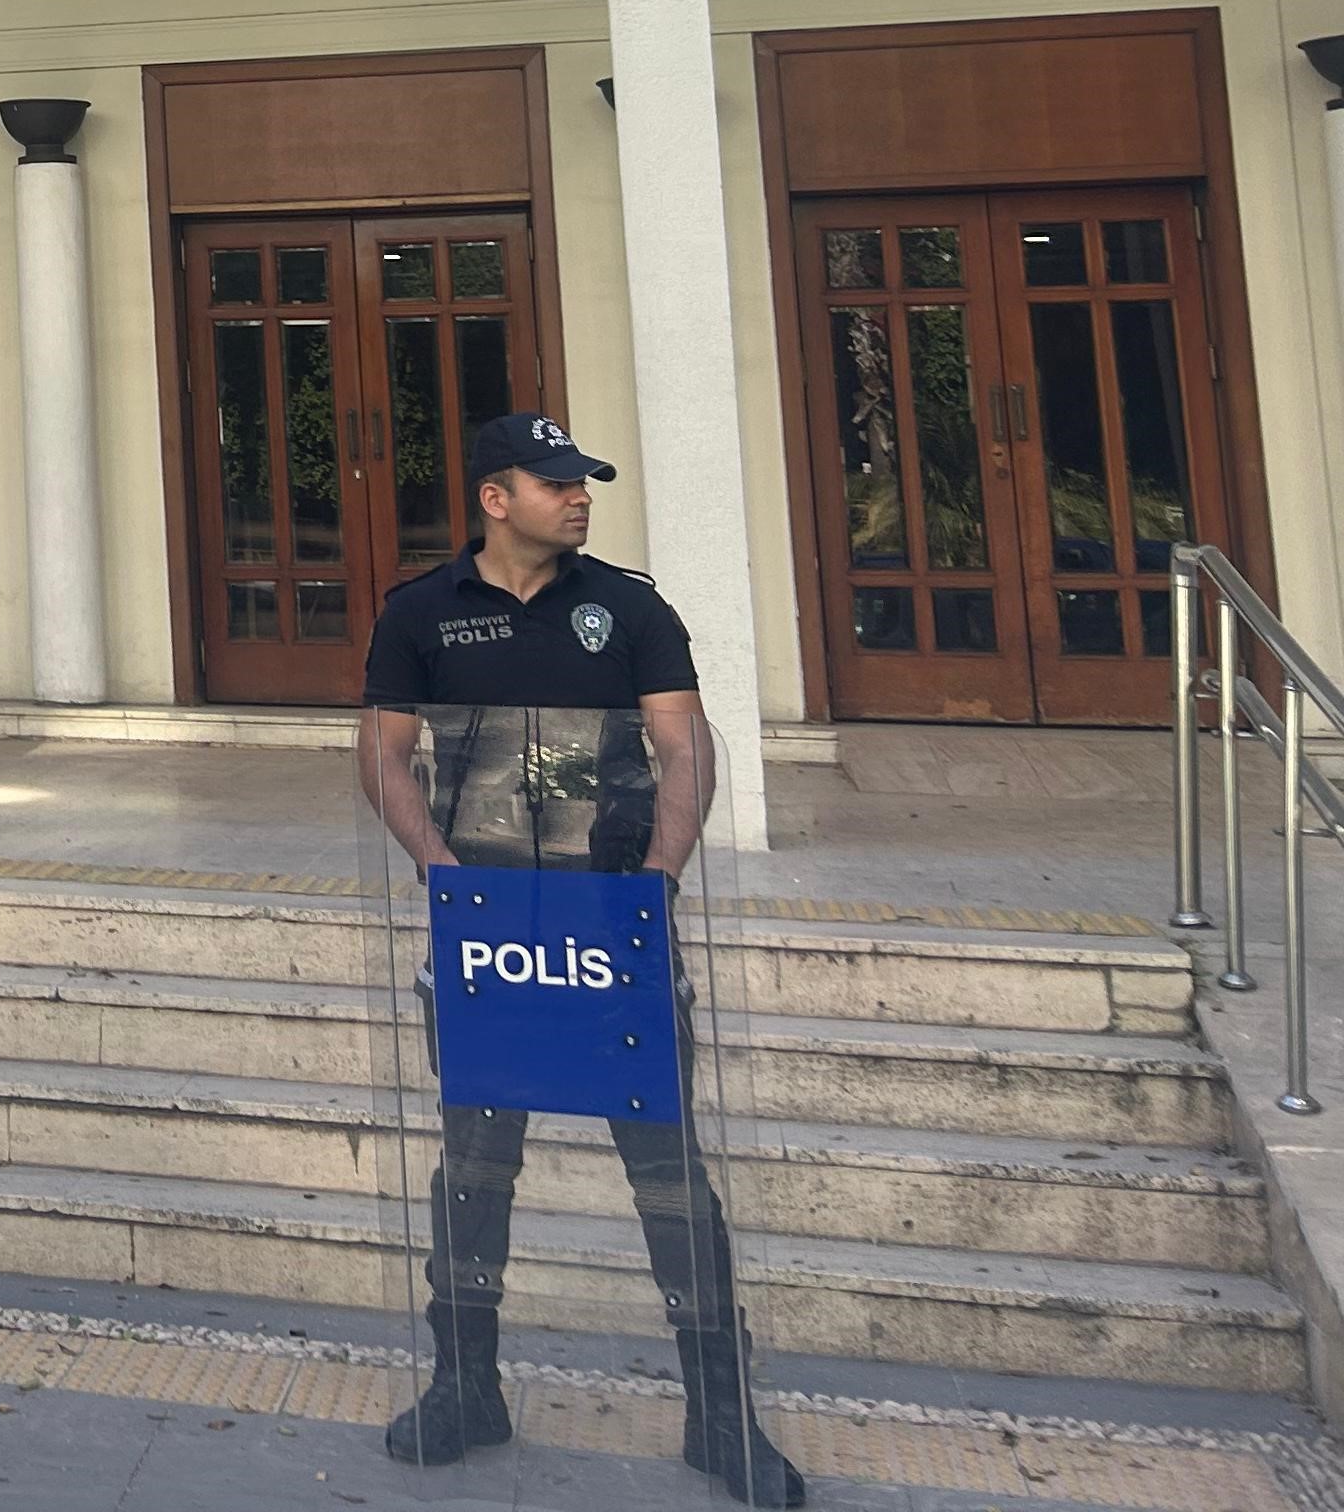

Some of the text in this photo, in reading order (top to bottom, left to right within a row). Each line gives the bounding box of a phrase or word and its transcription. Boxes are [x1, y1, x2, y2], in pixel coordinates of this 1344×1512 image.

[470, 615, 511, 627] KUVVET
[442, 625, 514, 648] POLİS
[460, 936, 614, 989] POLİS
